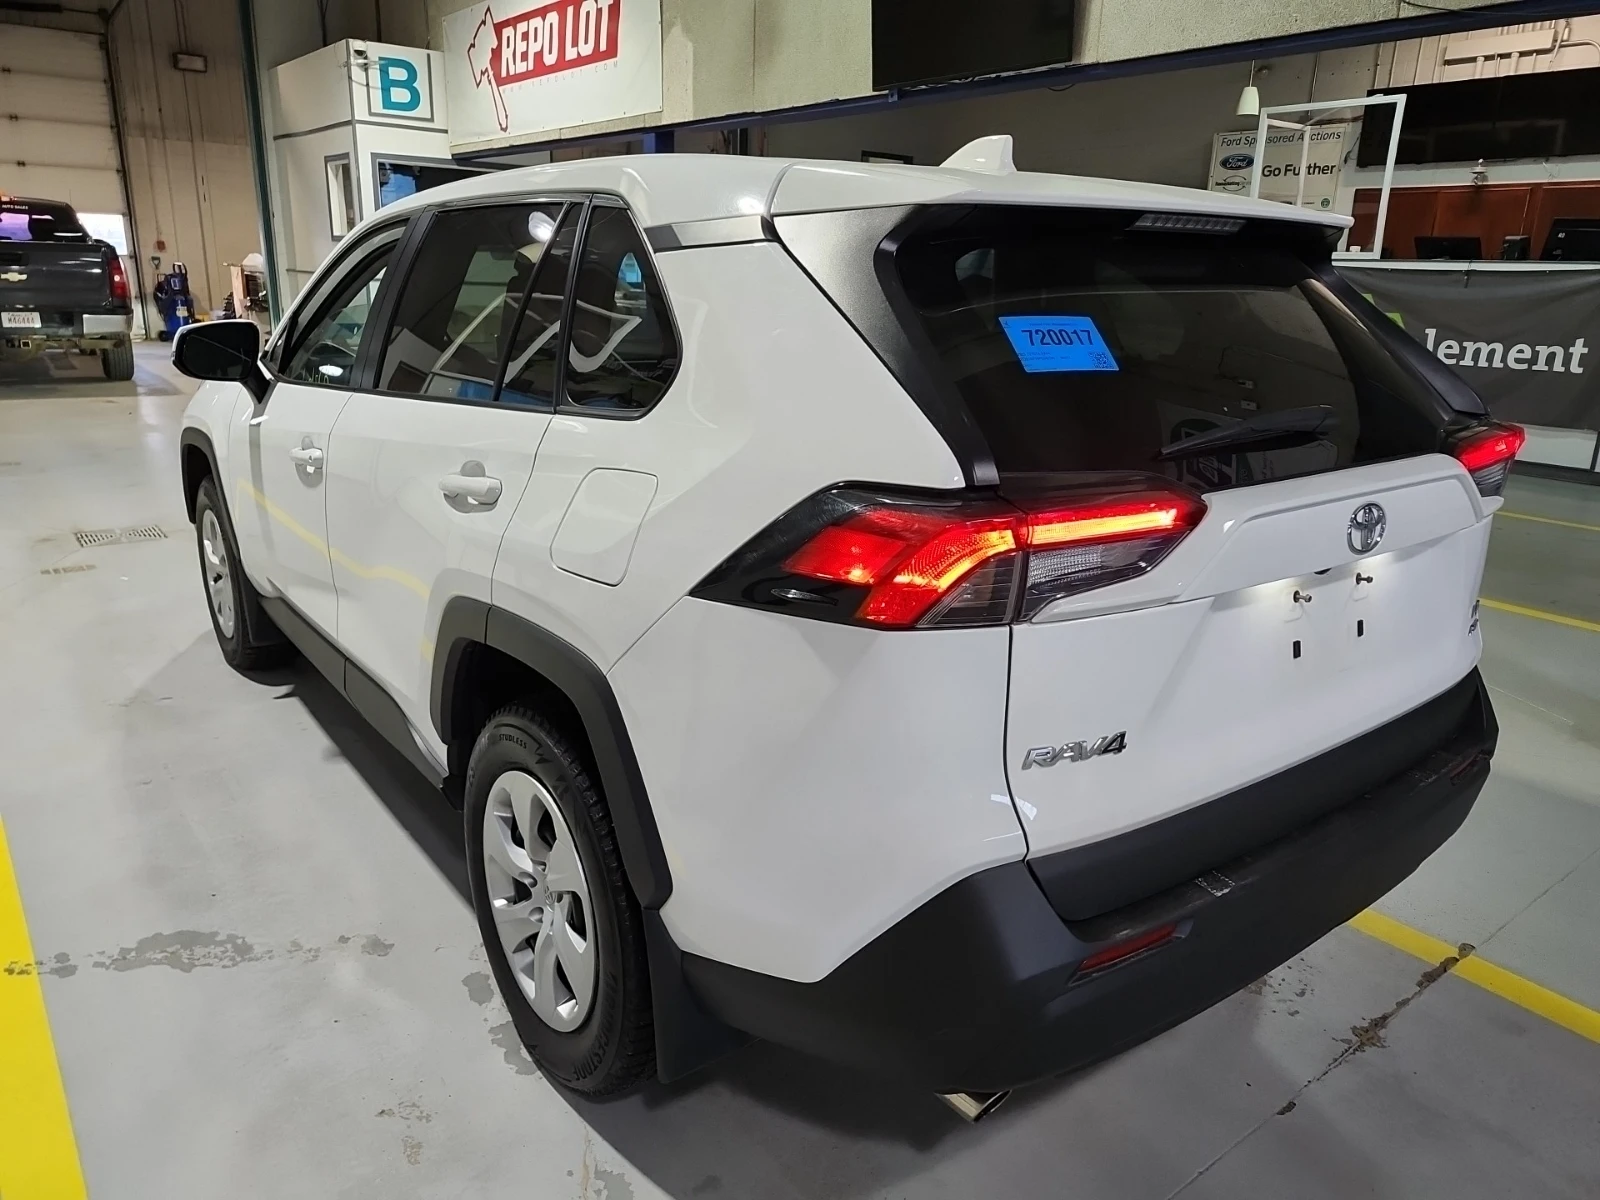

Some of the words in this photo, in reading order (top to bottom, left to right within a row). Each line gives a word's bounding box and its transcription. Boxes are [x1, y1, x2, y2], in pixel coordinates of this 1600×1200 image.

[500, 9, 560, 78] REPO
[564, 0, 614, 61] LOT
[378, 56, 421, 112] B
[1221, 136, 1242, 147] Ford
[1244, 134, 1295, 146] Spsored
[1297, 131, 1341, 143] Actions
[1262, 165, 1282, 177] Go
[1284, 163, 1336, 177] Futher
[1021, 329, 1094, 346] 720017
[1425, 328, 1588, 374] lement
[498, 733, 527, 750] STUDLESS
[1021, 730, 1127, 770] RAV4
